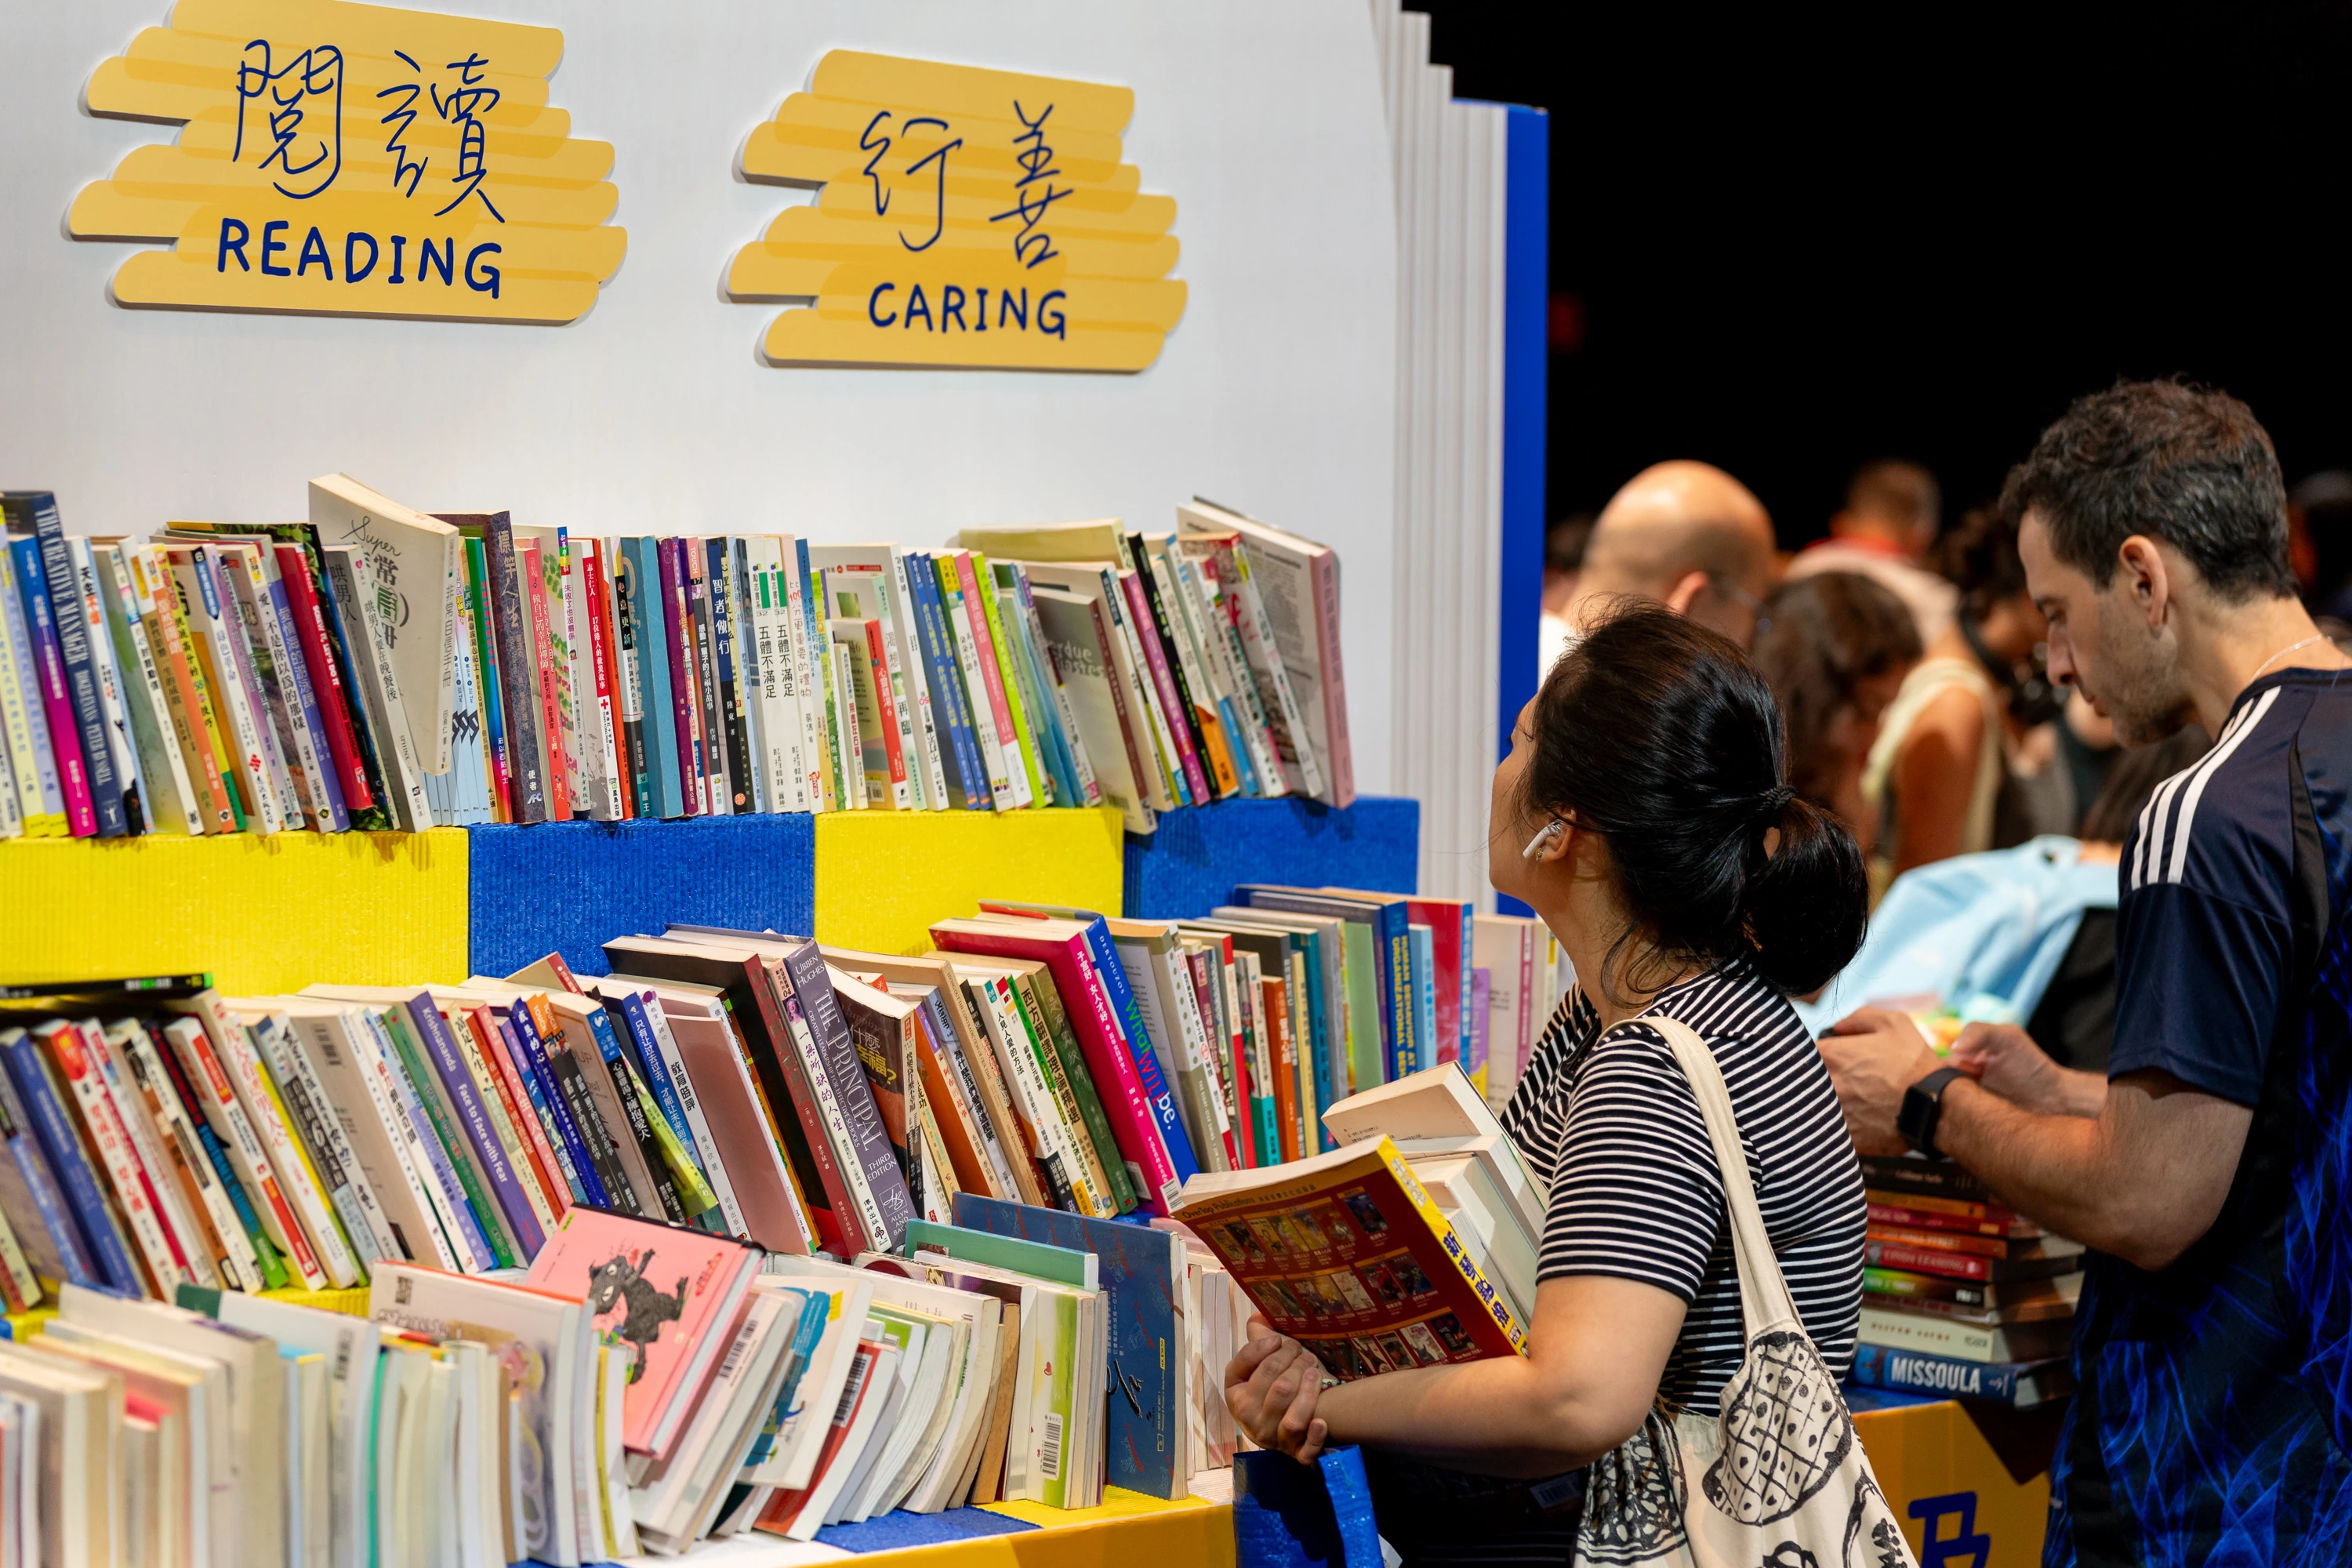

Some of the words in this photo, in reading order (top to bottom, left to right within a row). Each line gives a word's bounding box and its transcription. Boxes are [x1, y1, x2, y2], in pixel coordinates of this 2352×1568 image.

[234, 38, 506, 223] 閱讀
[859, 100, 1074, 269] 行善
[217, 217, 500, 300] READING
[869, 282, 1066, 341] CARING
[34, 504, 62, 538] THE
[339, 516, 401, 557] Super
[42, 537, 78, 603] CREATIVE
[330, 564, 358, 622] 哄男人
[498, 530, 519, 628] 標竿人生
[54, 601, 91, 666] MANAGER
[313, 604, 325, 632] SCREW
[532, 593, 550, 669] 做自己的幸福禪師
[564, 584, 575, 641] 失敗了也沒關係
[789, 580, 811, 698] 比100分更重要的禮物
[328, 663, 338, 677] DO
[332, 677, 340, 686] IT
[759, 626, 777, 699] 五體不滿足
[777, 624, 795, 697] 五體不滿足
[336, 687, 347, 720] RICHARD
[345, 721, 358, 759] BRANSON
[898, 700, 912, 736] 再臨
[528, 770, 537, 791] 使者
[794, 954, 818, 975] UBBEN
[796, 964, 825, 988] HUGHES
[1099, 935, 1125, 995] DERTOUZOS
[1400, 935, 1410, 981] HUMAN
[533, 1004, 547, 1033] TOUCH
[543, 1003, 558, 1031] TOUCH
[782, 989, 793, 998] 04
[814, 989, 840, 1032] THE
[1090, 984, 1108, 1023] 女人才好
[1389, 937, 1406, 1047] ORGANIZATIONAL
[422, 1007, 457, 1073] Krishnananda
[960, 1008, 979, 1051] CONTRADICTION
[983, 1068, 992, 1080] TIME
[996, 1011, 1024, 1076] 人見人愛的方法
[1124, 997, 1152, 1054] What
[800, 1031, 844, 1131] 一無所缺的人生
[806, 1010, 822, 1040] CREATIVE
[817, 1038, 834, 1074] LEADERSHIP
[829, 1074, 839, 1088] FOR
[834, 1087, 851, 1118] EFFECTIVE
[844, 1117, 861, 1148] SCHOOLS
[1021, 987, 1082, 1126] 西方翻譯理論精選
[1136, 1051, 1159, 1107] WILL
[613, 1062, 652, 1142] 心靈雞湯之擁抱愛犬
[661, 1087, 690, 1147] 才能让未来到来
[826, 1027, 884, 1152] PRINCIPAL
[942, 1065, 968, 1119] 阿布的故事
[458, 1083, 473, 1106] Face
[468, 1105, 477, 1118] to
[473, 1116, 488, 1140] Face
[484, 1140, 500, 1163] with
[493, 1159, 508, 1183] Fear
[868, 1152, 891, 1170] THIRD
[866, 1159, 898, 1181] EDITION
[891, 1208, 909, 1223] ALLYN
[895, 1216, 909, 1228] AND
[1214, 1193, 1255, 1213] Publications
[1890, 1357, 1981, 1395] MISSOULA
